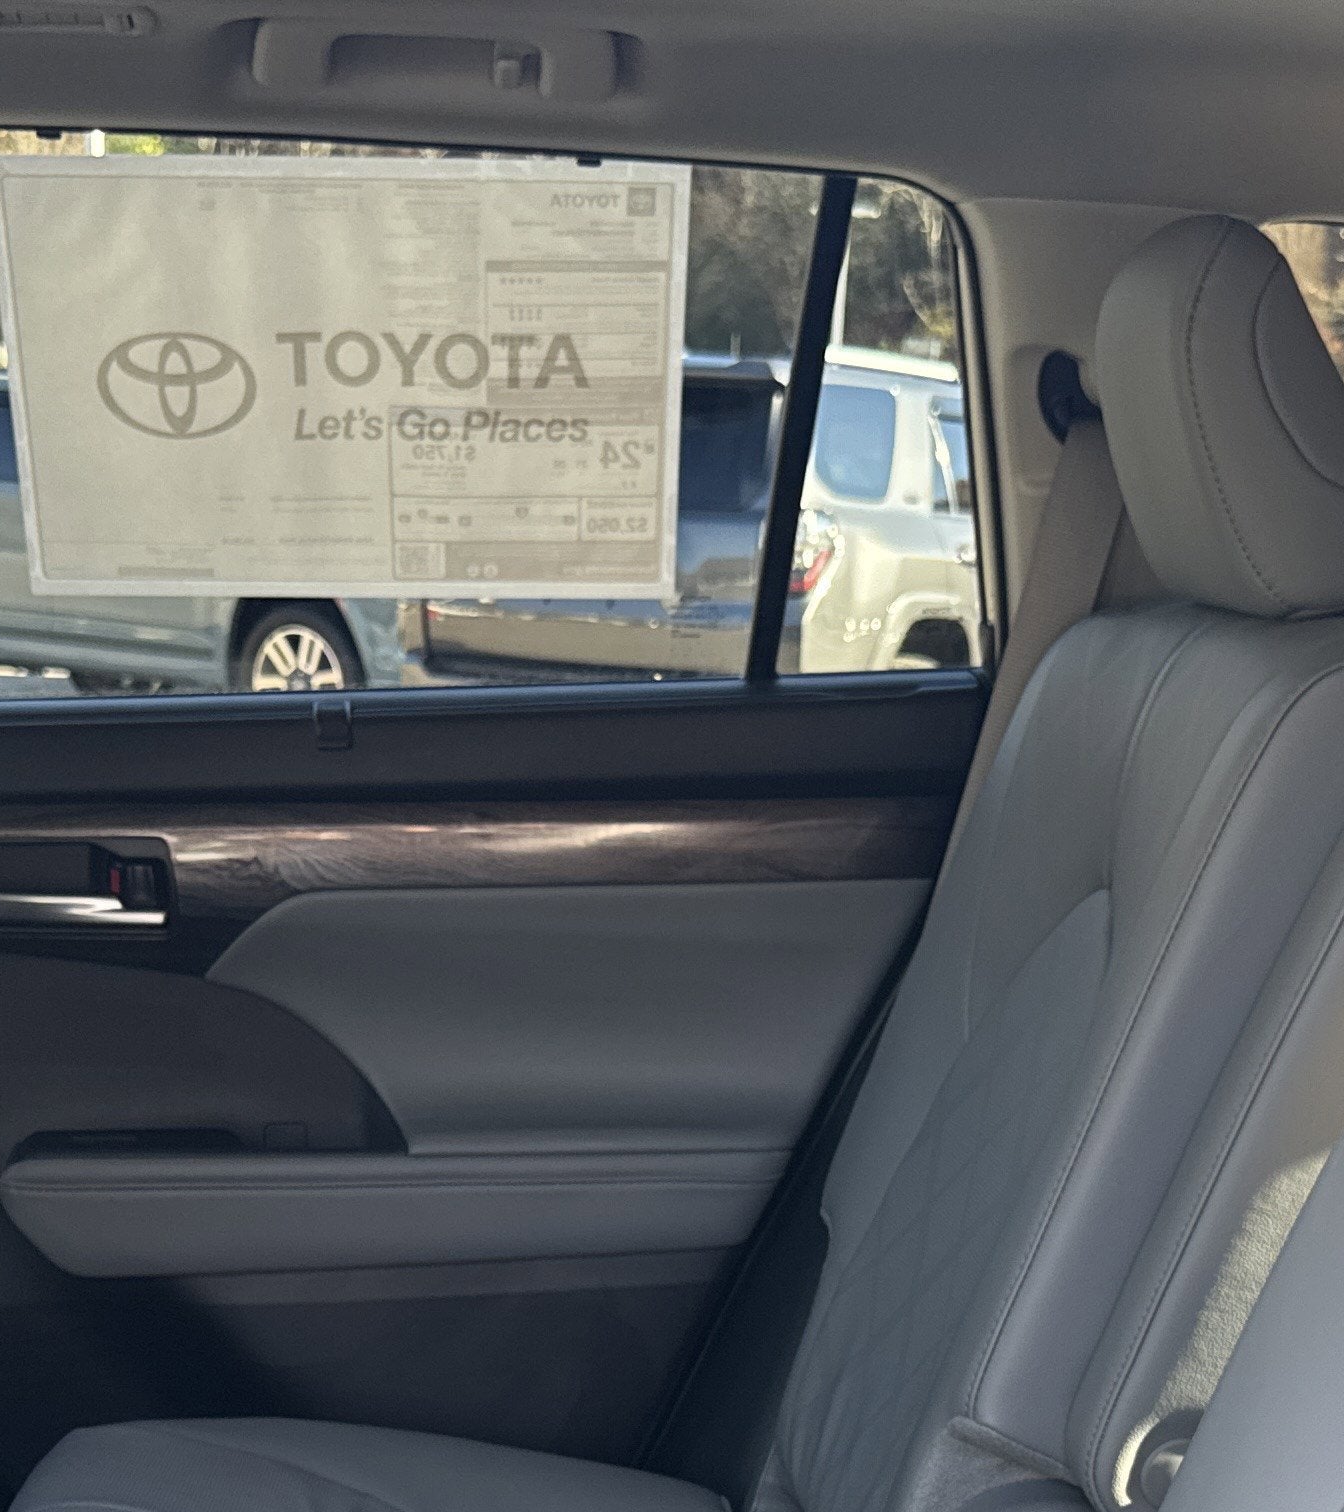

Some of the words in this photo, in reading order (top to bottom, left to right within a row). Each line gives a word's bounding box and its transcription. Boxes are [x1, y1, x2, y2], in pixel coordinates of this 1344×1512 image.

[275, 330, 590, 389] TOYOTA
[293, 406, 386, 441] Let's
[397, 408, 452, 442] Go
[461, 409, 590, 443] Places
